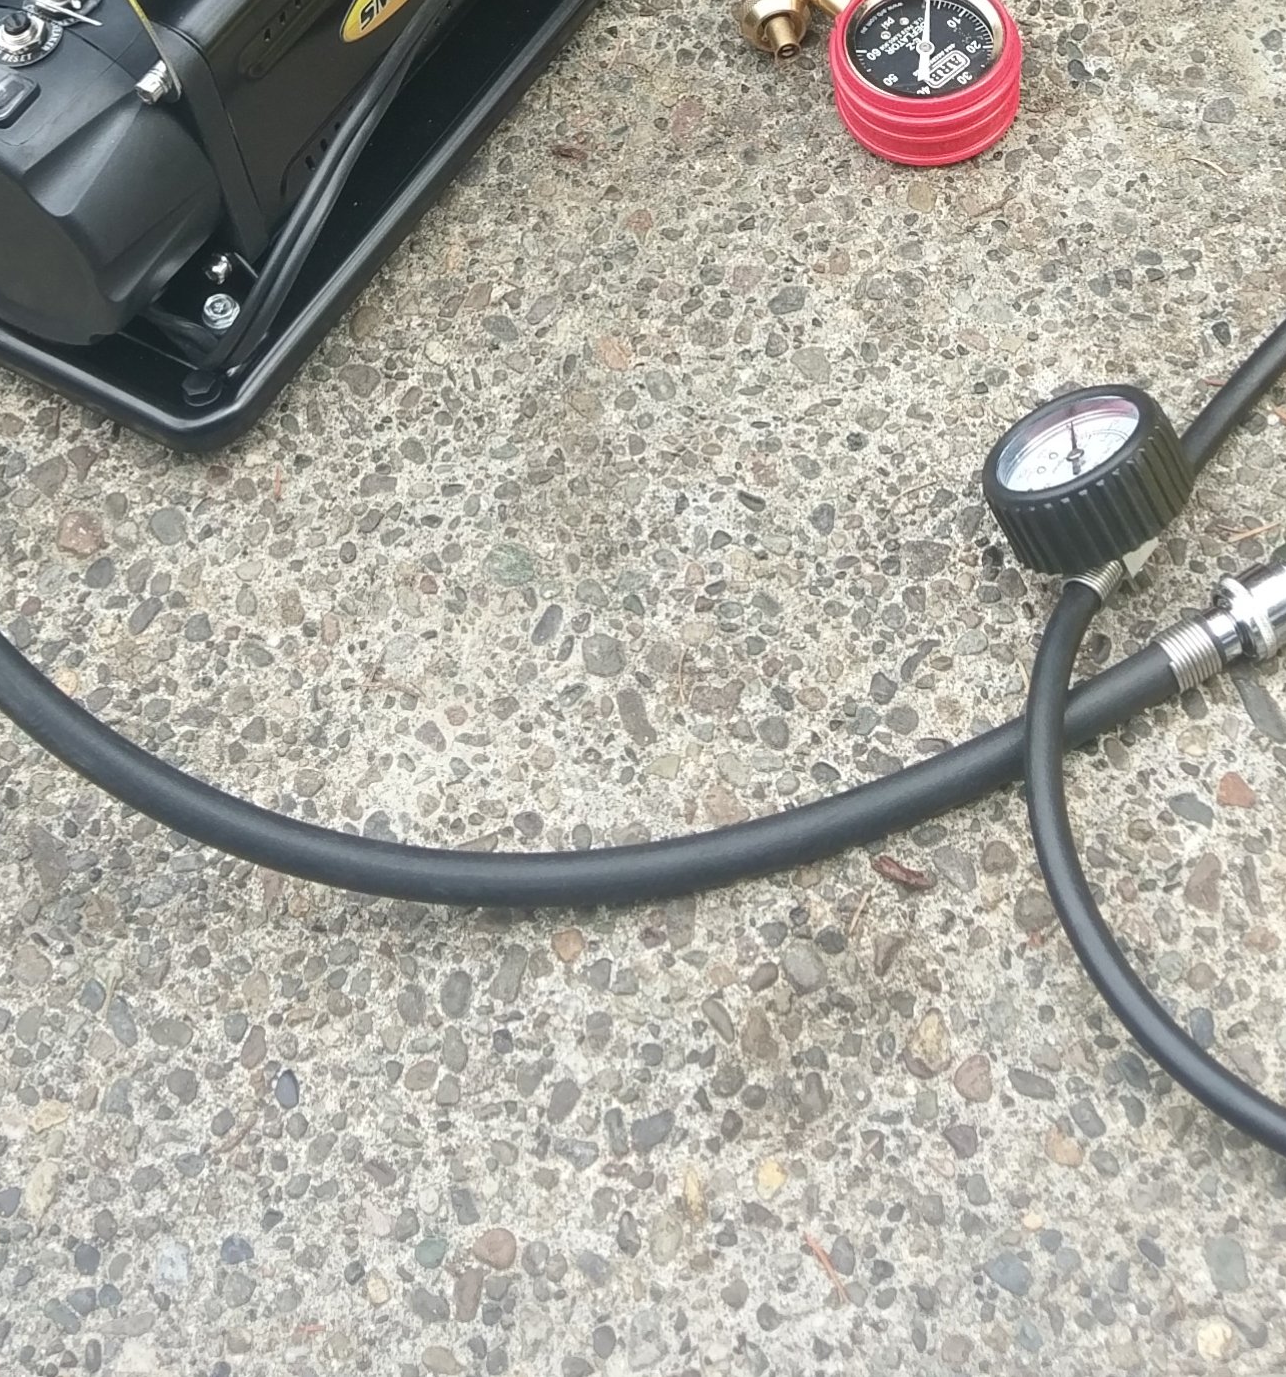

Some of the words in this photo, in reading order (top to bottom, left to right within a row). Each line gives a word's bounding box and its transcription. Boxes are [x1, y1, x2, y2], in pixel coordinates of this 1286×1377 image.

[880, 16, 895, 30] psi
[946, 16, 961, 28] 10
[965, 40, 981, 53] 20
[1, 53, 32, 62] RESET
[866, 48, 881, 61] 60
[929, 55, 962, 83] ARB
[882, 73, 898, 86] 50
[957, 71, 973, 85] 30
